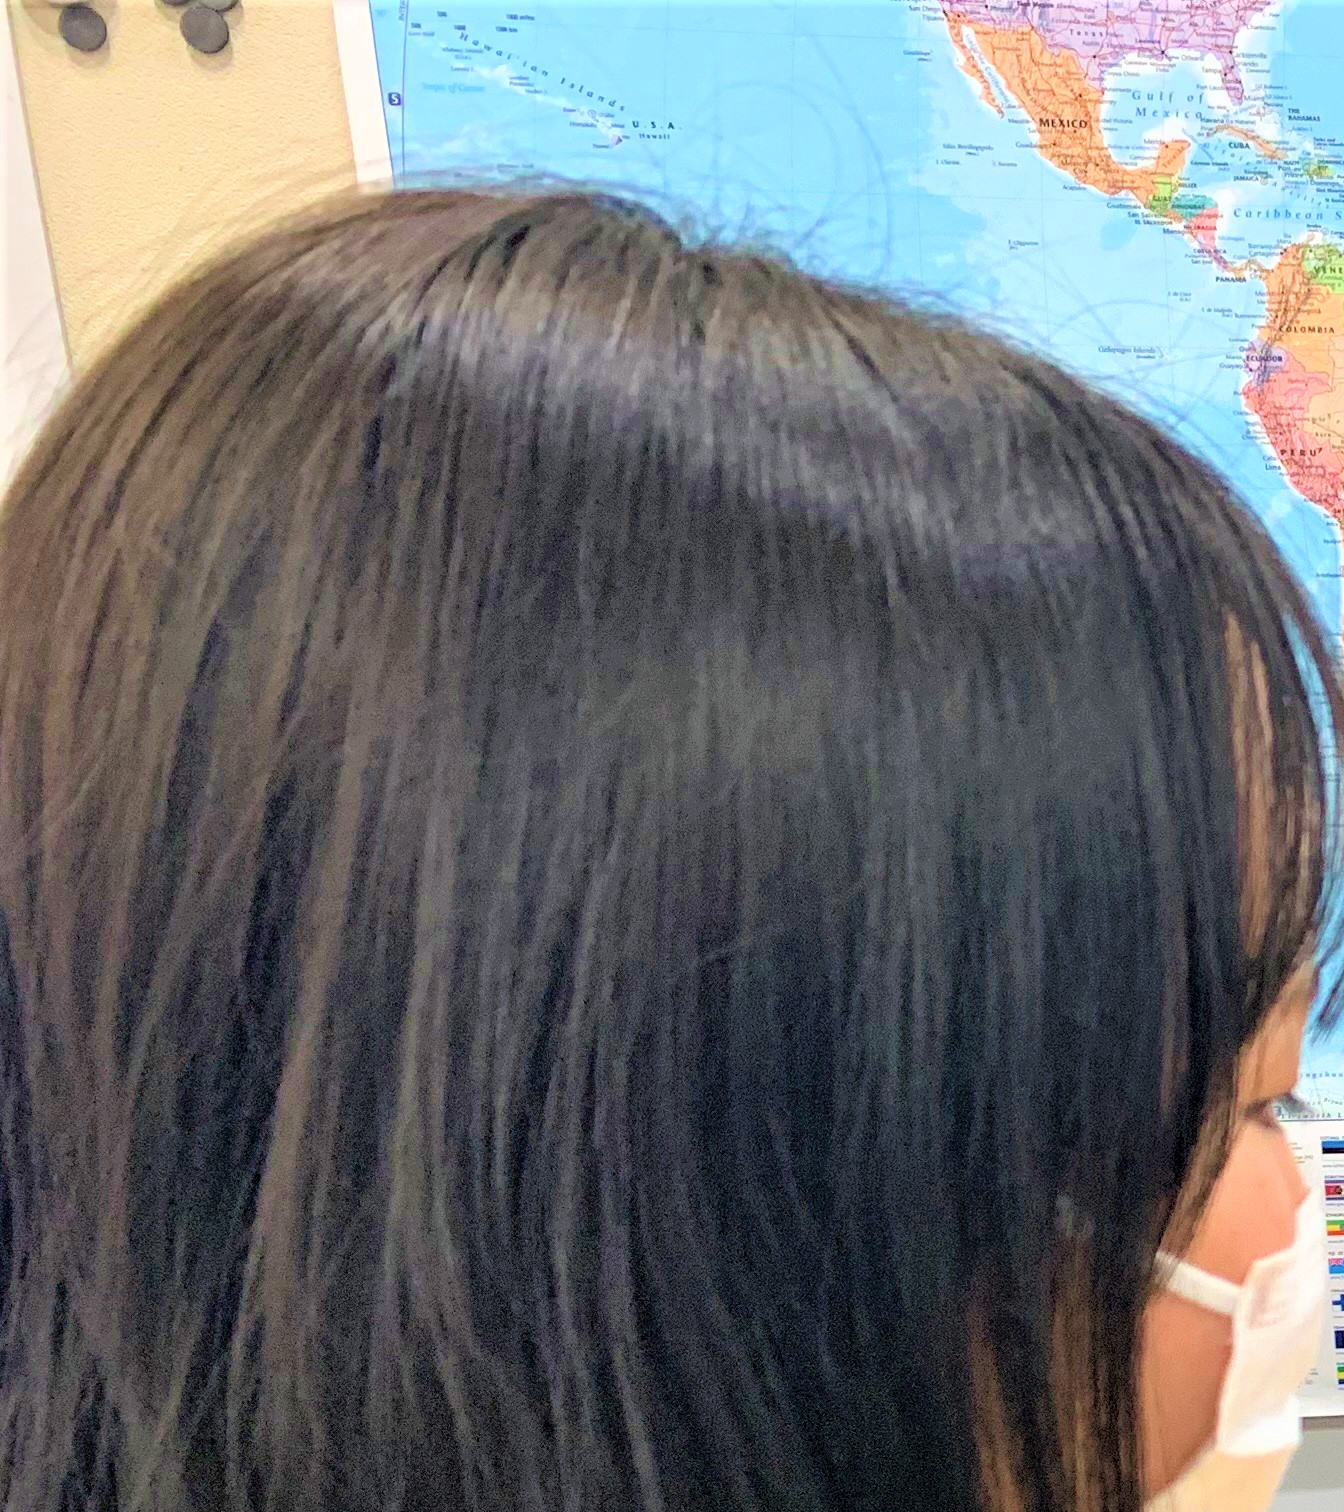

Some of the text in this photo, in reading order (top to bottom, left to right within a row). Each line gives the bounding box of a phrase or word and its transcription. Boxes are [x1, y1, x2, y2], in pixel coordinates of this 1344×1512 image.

[1135, 107, 1203, 119] Mexico
[1039, 118, 1088, 130] MEXICO
[1279, 325, 1335, 334] COLOMBIA
